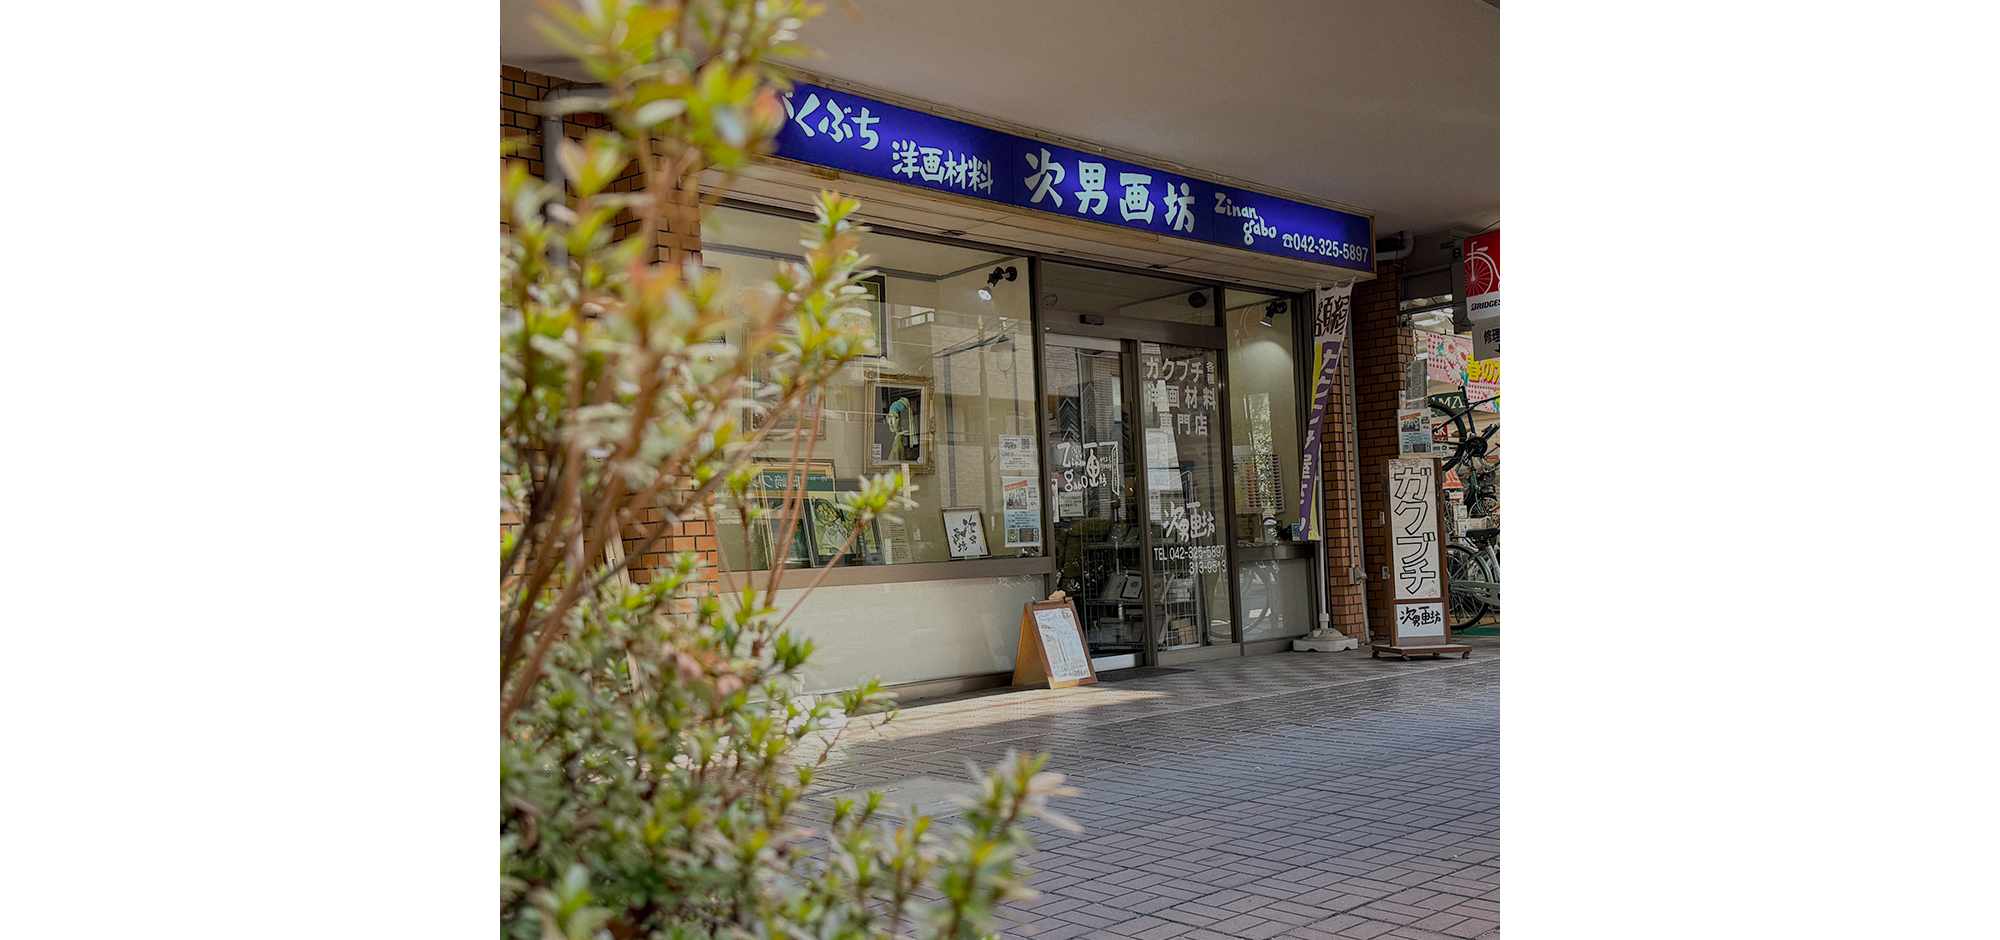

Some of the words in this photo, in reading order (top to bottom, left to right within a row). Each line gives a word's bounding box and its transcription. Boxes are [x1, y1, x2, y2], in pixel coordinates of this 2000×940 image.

[781, 91, 880, 150] くぶち
[892, 139, 994, 195] 洋画材料
[1024, 148, 1197, 233] 次男画坊
[1214, 192, 1258, 219] Zinan
[1242, 216, 1277, 246] gabo
[1146, 357, 1204, 383] ガクブチ
[1160, 412, 1208, 436] 専門店
[1162, 501, 1215, 542] 次男画坊
[1394, 467, 1436, 595] ガクブチ
[1154, 547, 1168, 560] TEL
[1169, 545, 1225, 561] 042-325-5897
[1399, 606, 1441, 627] 次男画坊
